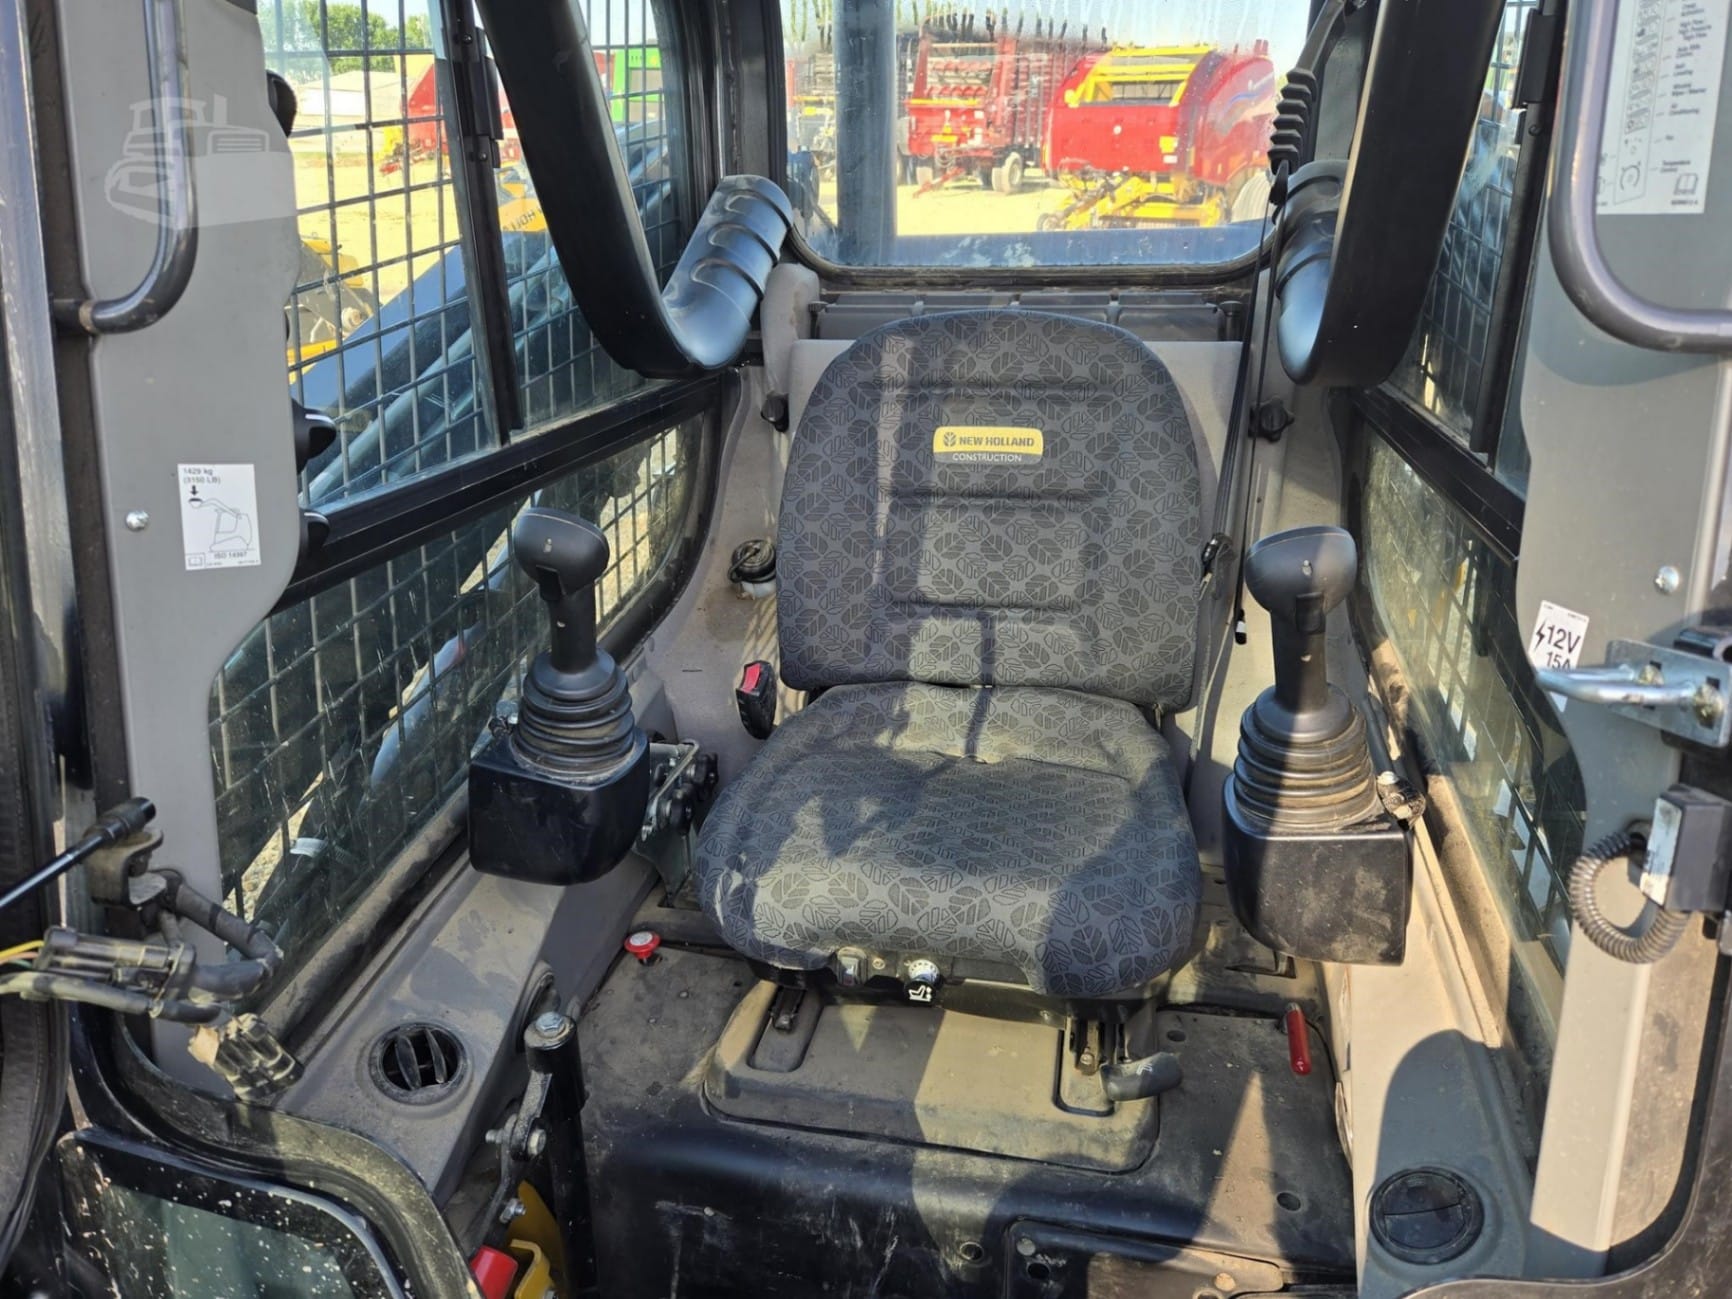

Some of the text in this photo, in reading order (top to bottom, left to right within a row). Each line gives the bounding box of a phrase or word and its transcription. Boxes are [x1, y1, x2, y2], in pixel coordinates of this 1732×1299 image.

[959, 436, 1035, 447] NEW HOLLAND
[952, 452, 1022, 462] CONSTRUCTION
[1547, 625, 1581, 655] 12V
